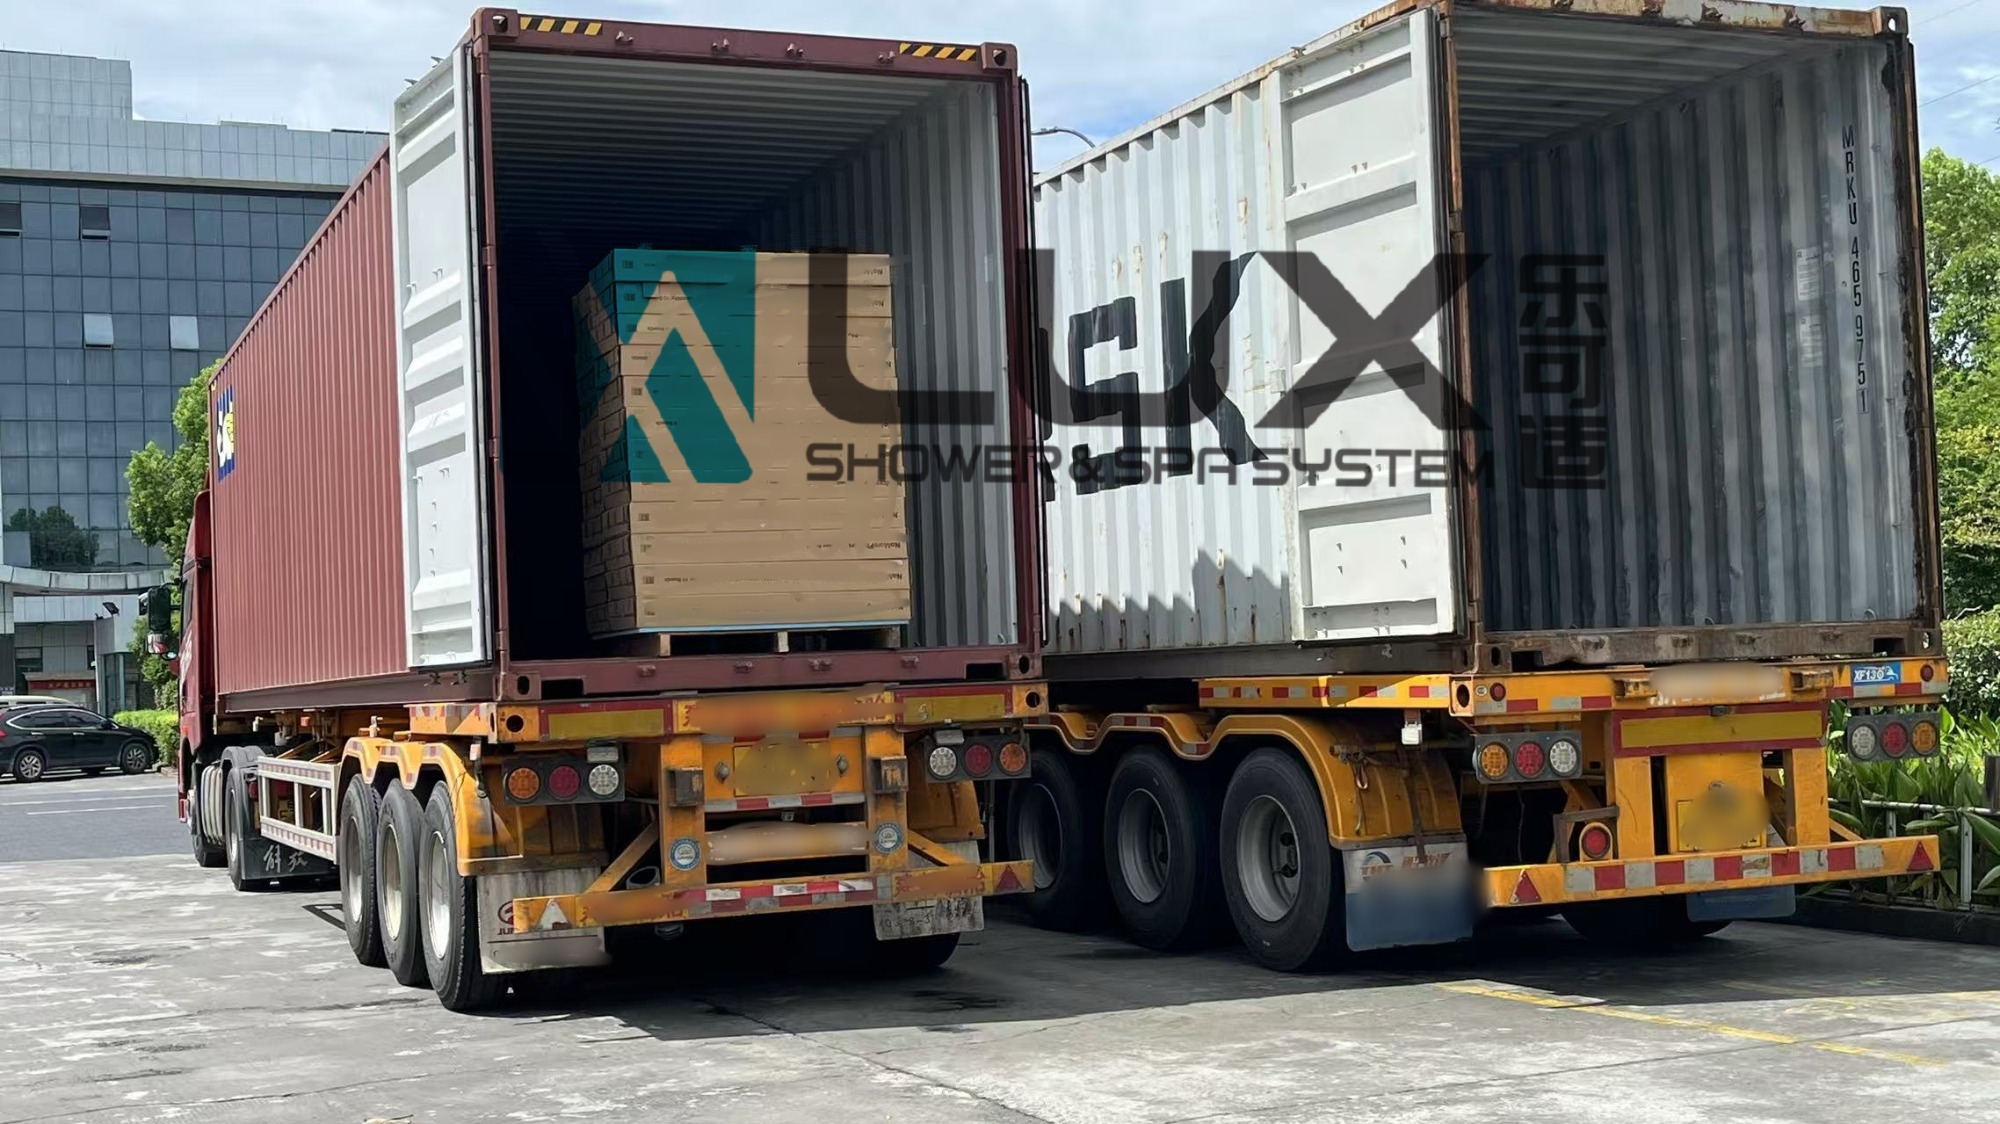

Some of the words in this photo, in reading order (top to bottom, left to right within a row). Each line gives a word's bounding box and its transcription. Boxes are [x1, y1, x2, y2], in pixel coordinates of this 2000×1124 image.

[1841, 124, 1858, 225] MRKU
[1851, 236, 1862, 307] 465
[1039, 252, 1269, 501] SK
[1855, 314, 1866, 385] 975
